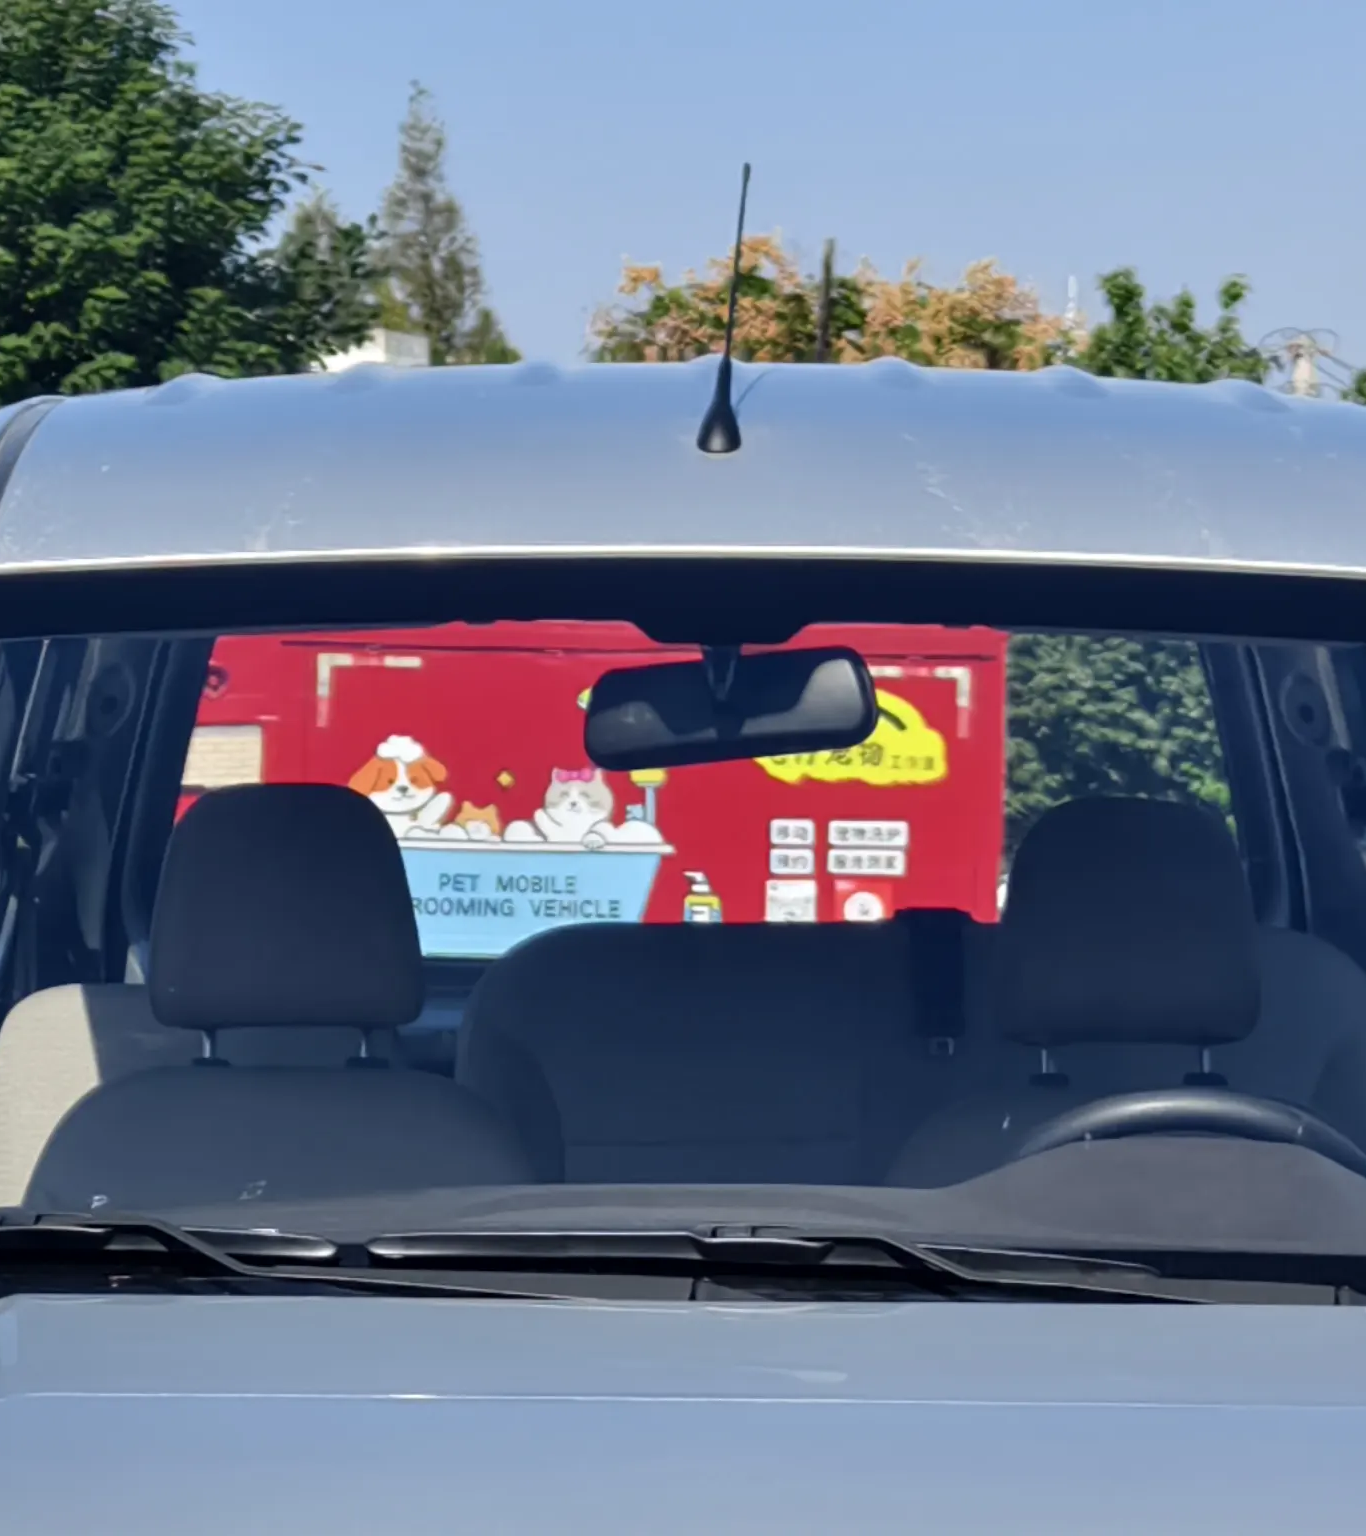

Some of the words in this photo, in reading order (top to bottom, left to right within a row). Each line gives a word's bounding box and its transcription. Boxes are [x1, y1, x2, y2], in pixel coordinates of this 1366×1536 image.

[438, 873, 481, 893] PET
[496, 874, 577, 895] MOBILE
[411, 896, 515, 918] ROOMING
[529, 898, 622, 919] VEHICLE
